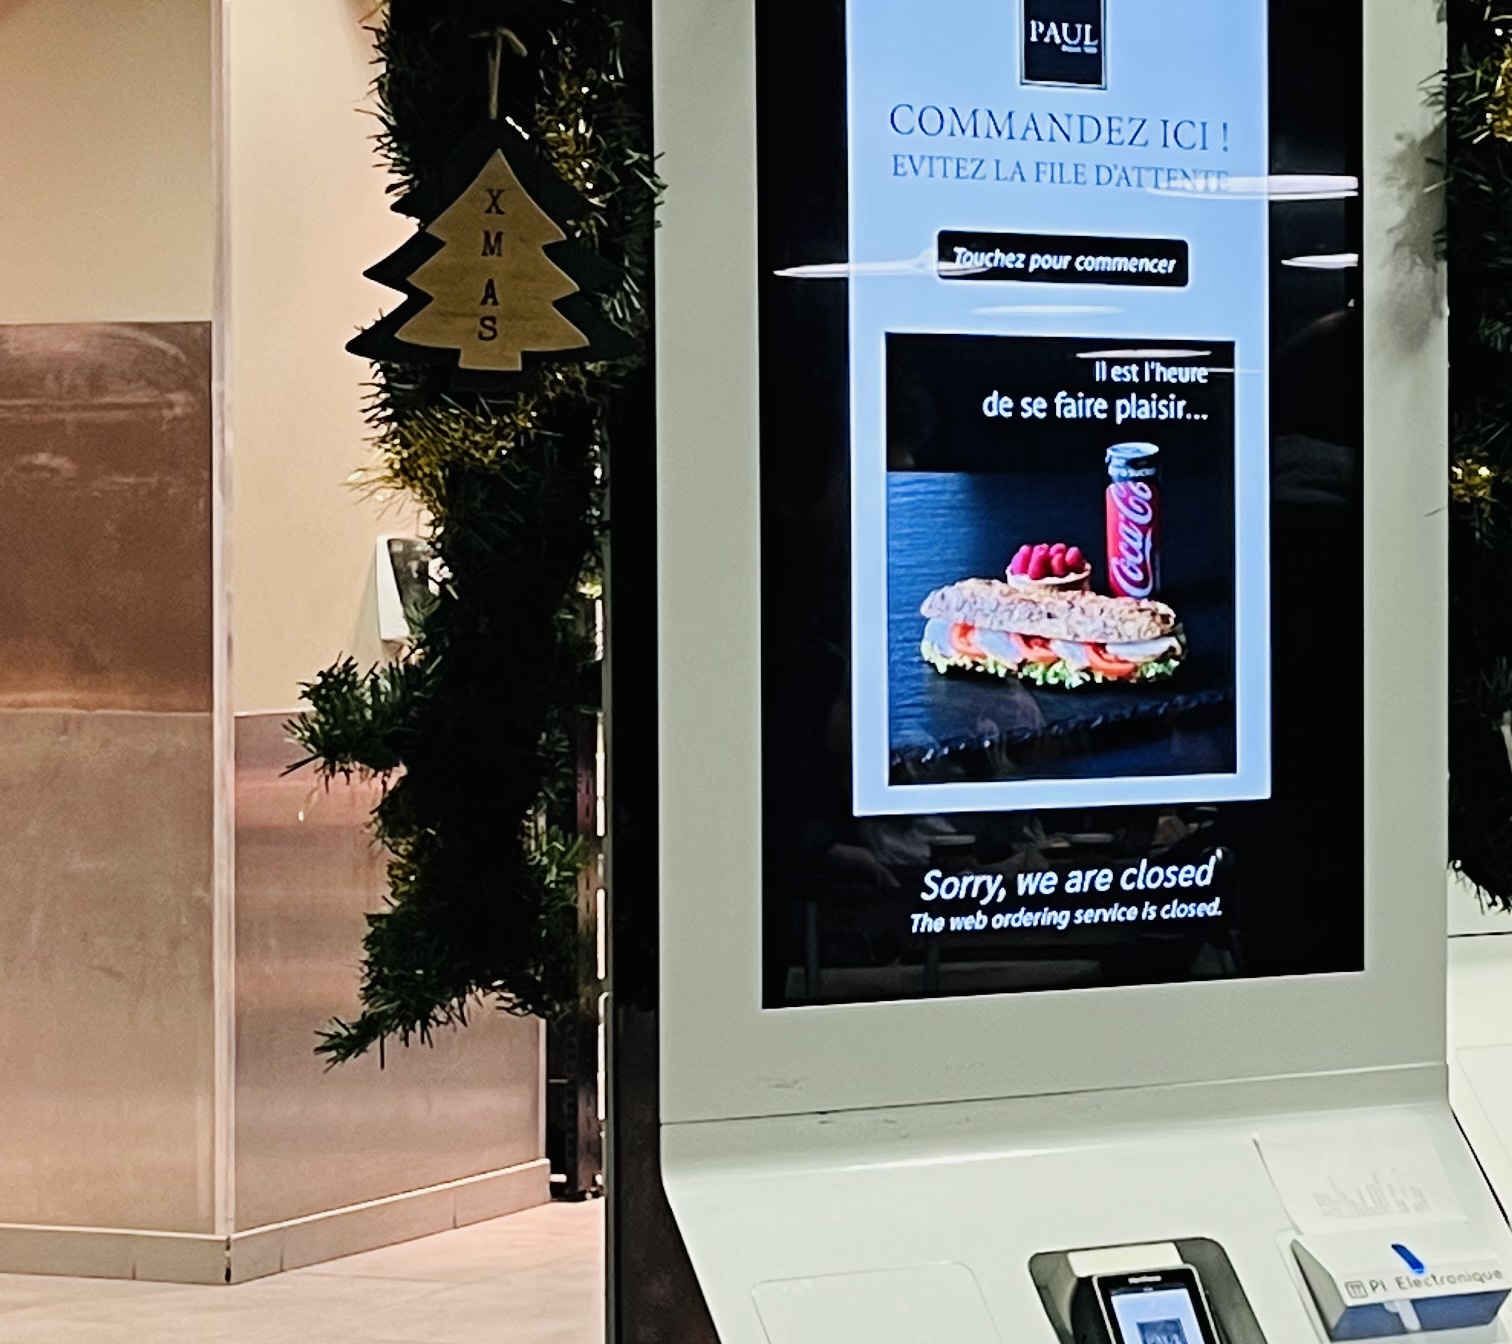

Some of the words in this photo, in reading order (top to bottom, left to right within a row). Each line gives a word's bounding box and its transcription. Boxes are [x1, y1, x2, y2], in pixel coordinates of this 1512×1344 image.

[1029, 19, 1099, 45] PAUL
[889, 103, 1150, 148] COMMANDEZ
[1159, 119, 1210, 150] ICI
[892, 154, 987, 181] EVITEZ
[993, 159, 1026, 183] LA
[1034, 161, 1088, 185] FILE
[952, 246, 1026, 270] Touchez
[1028, 254, 1070, 273] pour
[1074, 255, 1177, 275] commencer
[1110, 364, 1140, 384] est
[982, 389, 1015, 419] de
[1020, 396, 1048, 420] se
[1054, 390, 1109, 420] faire
[920, 869, 1007, 906] Sorry,
[1016, 870, 1059, 896] we
[1064, 867, 1114, 894] are
[1120, 855, 1216, 891] closed
[910, 913, 946, 934] The
[949, 910, 989, 931] web
[991, 907, 1071, 931] ordering
[1073, 903, 1139, 925] service
[1141, 902, 1157, 921] is
[1159, 896, 1224, 919] closed.
[1394, 1268, 1504, 1292] Electronique
